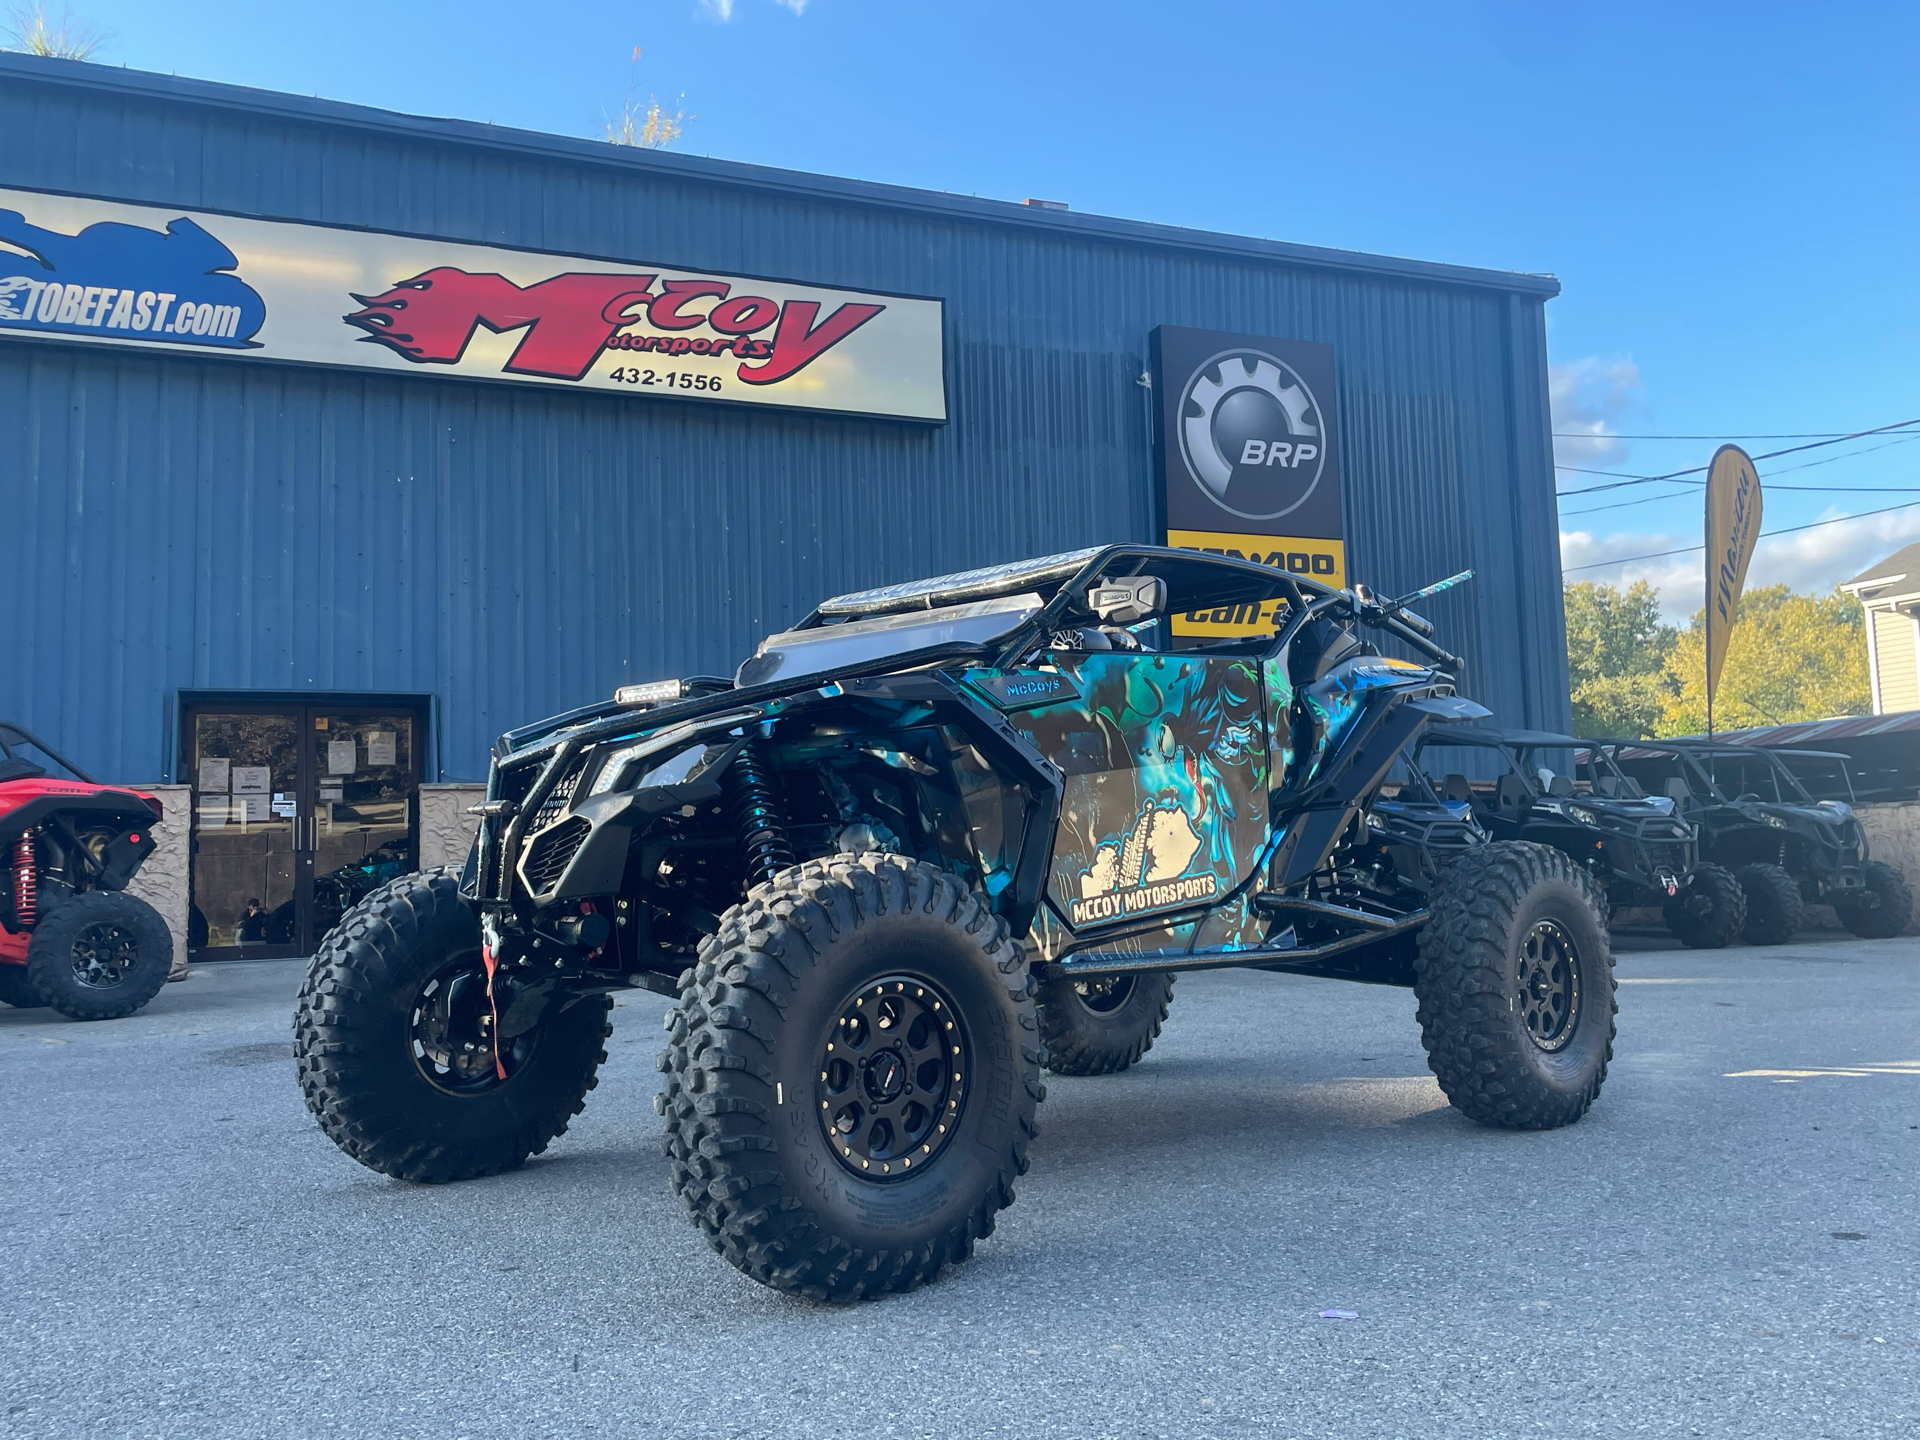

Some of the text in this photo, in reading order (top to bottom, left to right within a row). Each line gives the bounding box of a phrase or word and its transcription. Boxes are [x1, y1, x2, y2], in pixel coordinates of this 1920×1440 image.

[609, 366, 723, 393] 432-1556
[1239, 438, 1318, 469] BRP
[1005, 677, 1061, 697] McCoys
[1073, 875, 1216, 923] MCCOY MOTORSPORTS
